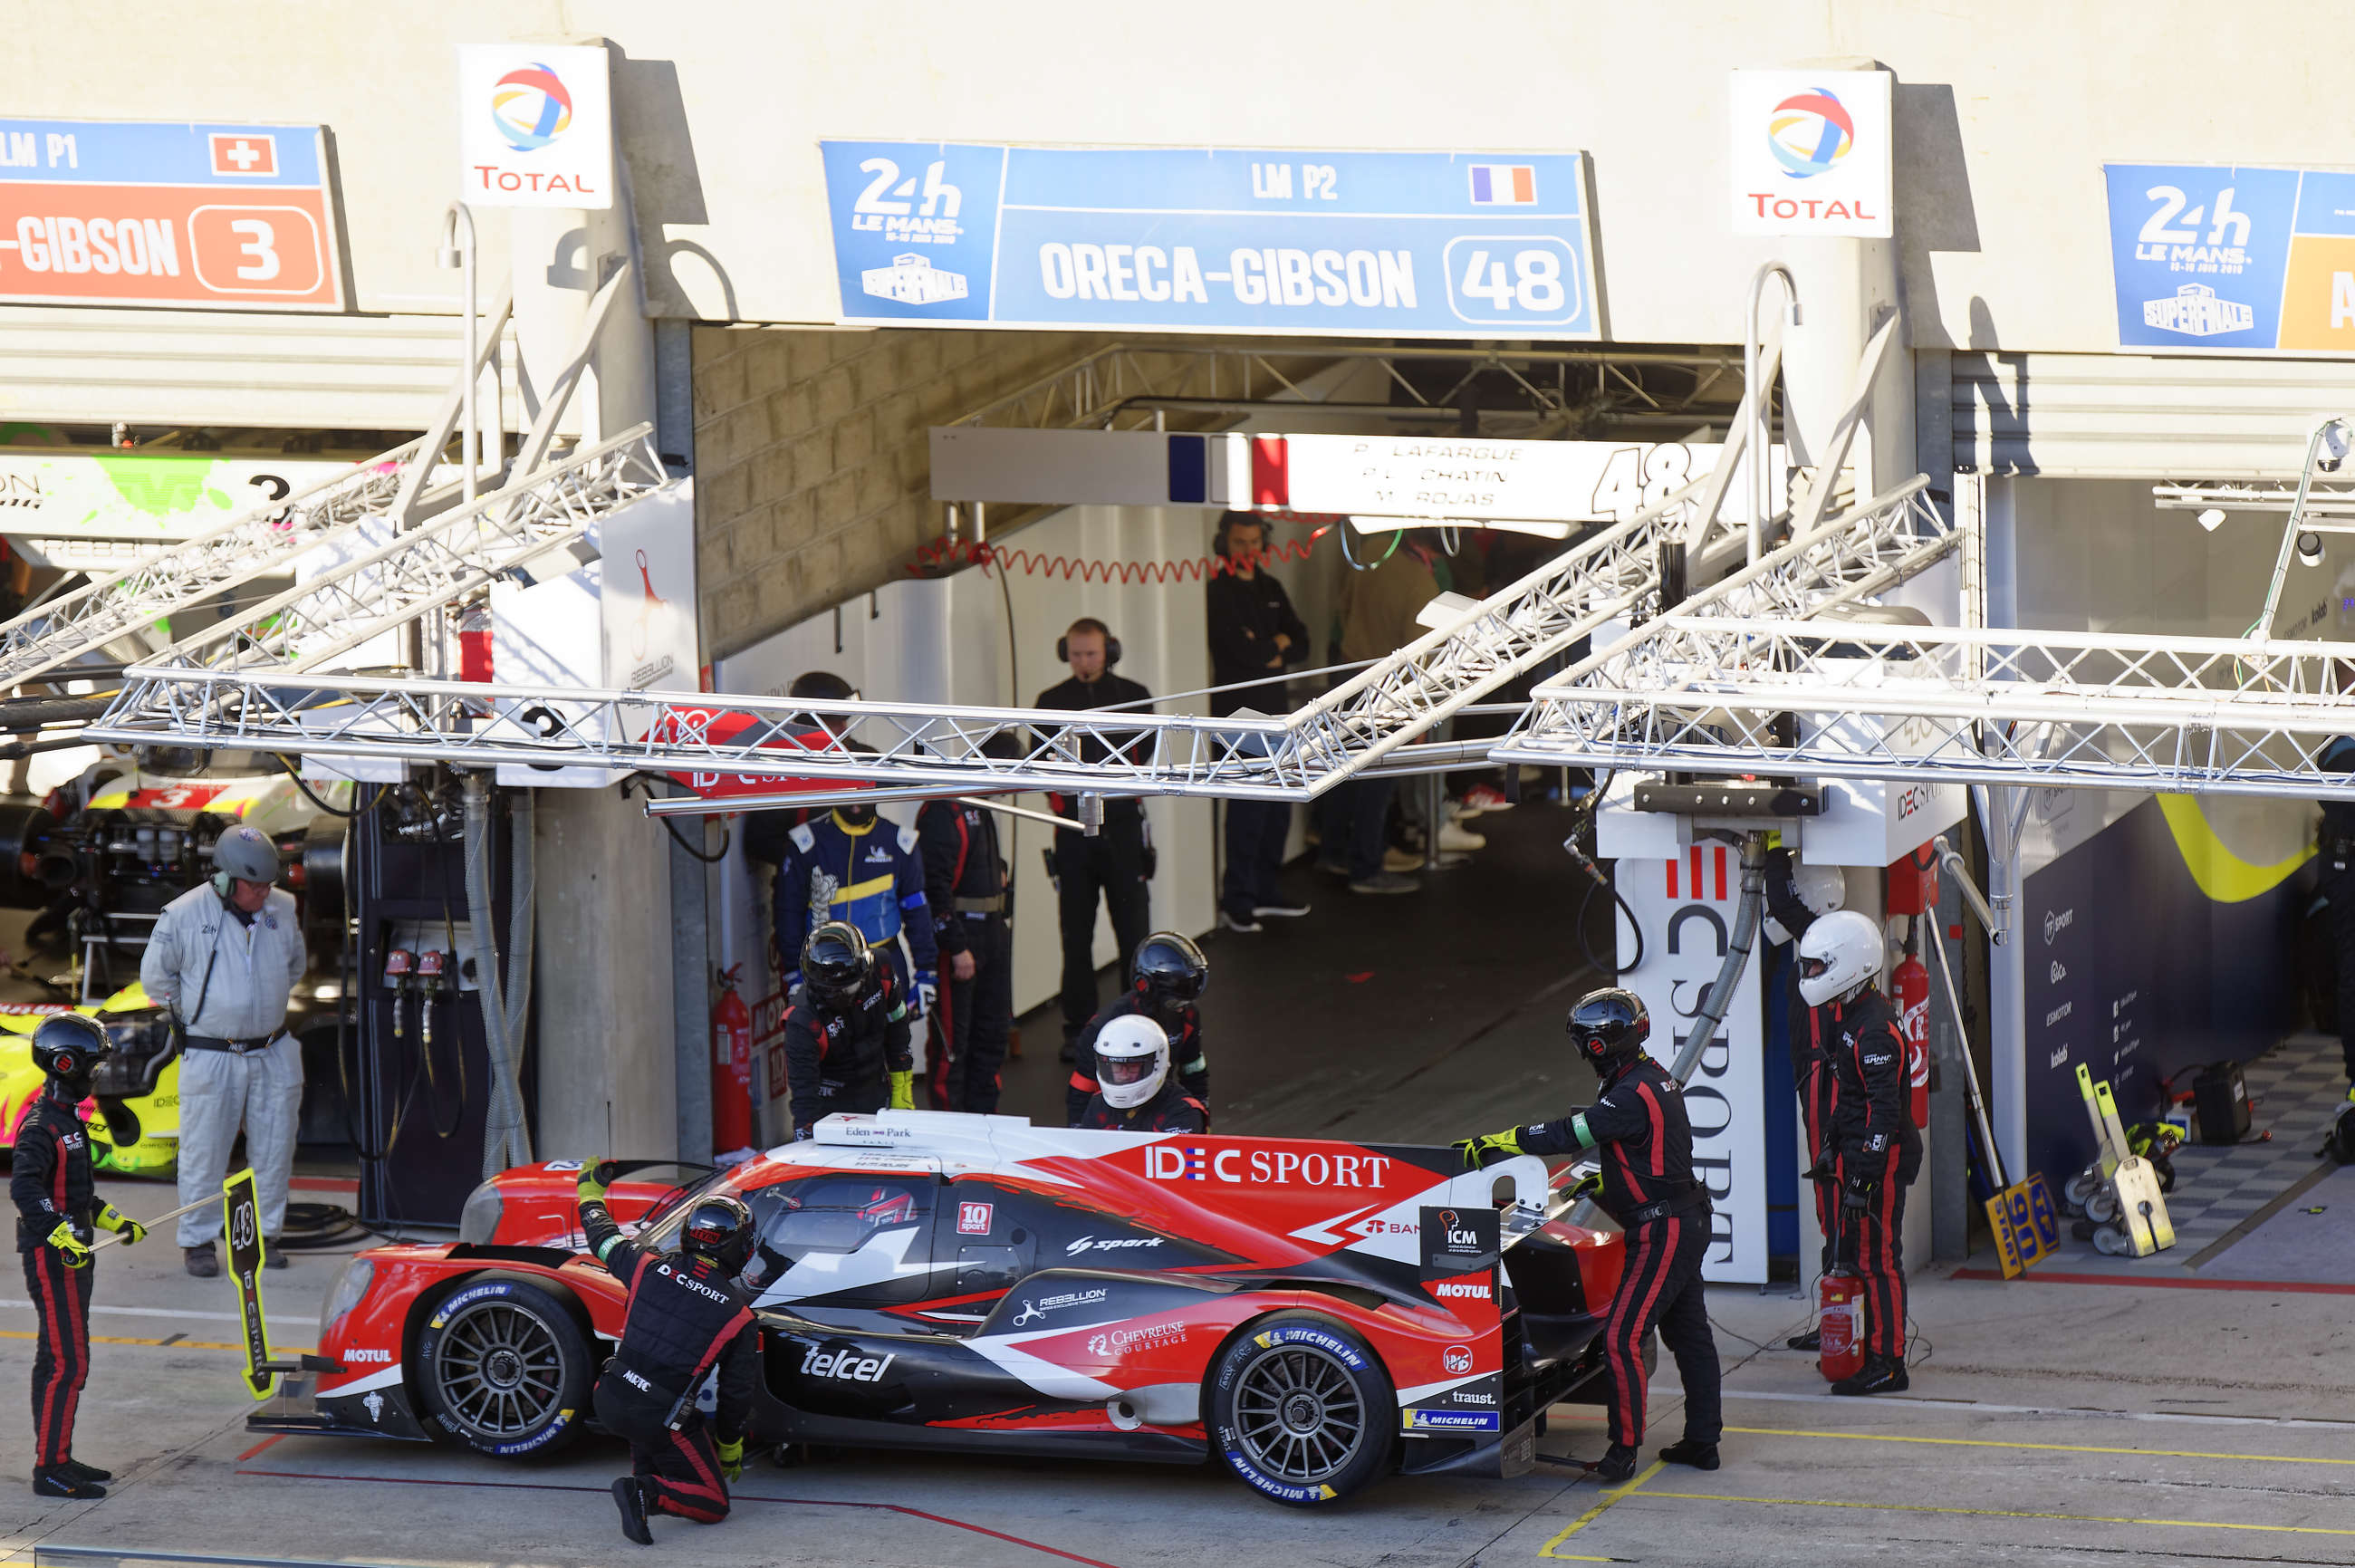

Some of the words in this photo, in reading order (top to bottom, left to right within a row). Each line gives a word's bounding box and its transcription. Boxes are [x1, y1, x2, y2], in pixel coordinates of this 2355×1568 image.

[46, 132, 79, 168] P1
[474, 165, 594, 193] TOTAL
[854, 158, 962, 217] 24h
[1253, 162, 1293, 199] LM
[1303, 163, 1339, 201] P2
[1748, 193, 1876, 220] TOTAL
[2139, 185, 2251, 246] 24h
[851, 214, 884, 231] LE
[231, 218, 281, 282] 3
[2136, 244, 2168, 261] LE
[1039, 242, 1418, 310] ORECA-GIBSON
[1460, 249, 1565, 313] 48
[1392, 444, 1524, 461] LAFARGUE
[1591, 442, 1692, 522] 48
[248, 473, 291, 524] 3
[150, 788, 193, 808] 3
[1898, 786, 1919, 822] IDEC
[2055, 909, 2073, 933] SPORT
[846, 1126, 870, 1136] Eden
[887, 1128, 911, 1138] Park
[1670, 979, 1734, 1265] SPORT
[1145, 1146, 1242, 1183] IDEC
[1251, 1150, 1390, 1188] SPORT
[232, 1200, 255, 1251] 48
[962, 1221, 985, 1232] sport
[963, 1206, 987, 1224] 10
[1093, 1237, 1166, 1251] spark
[1448, 1230, 1477, 1245] ICM
[448, 1286, 506, 1313] MICHELIN
[685, 1276, 730, 1304] SPORT
[1040, 1290, 1106, 1307] REBELLION
[1437, 1284, 1492, 1299] MOTUL
[1111, 1321, 1186, 1346] CHEVREUSE
[1115, 1333, 1188, 1356] COURTAGE
[343, 1349, 392, 1362] MOTUL
[1284, 1330, 1361, 1368] MICHELIN
[801, 1346, 897, 1382] telcel
[1452, 1390, 1496, 1405] traust.
[1430, 1416, 1488, 1426] MICHELIN
[500, 1429, 558, 1454] MICHELIN
[1232, 1457, 1304, 1500] MICHELIN
